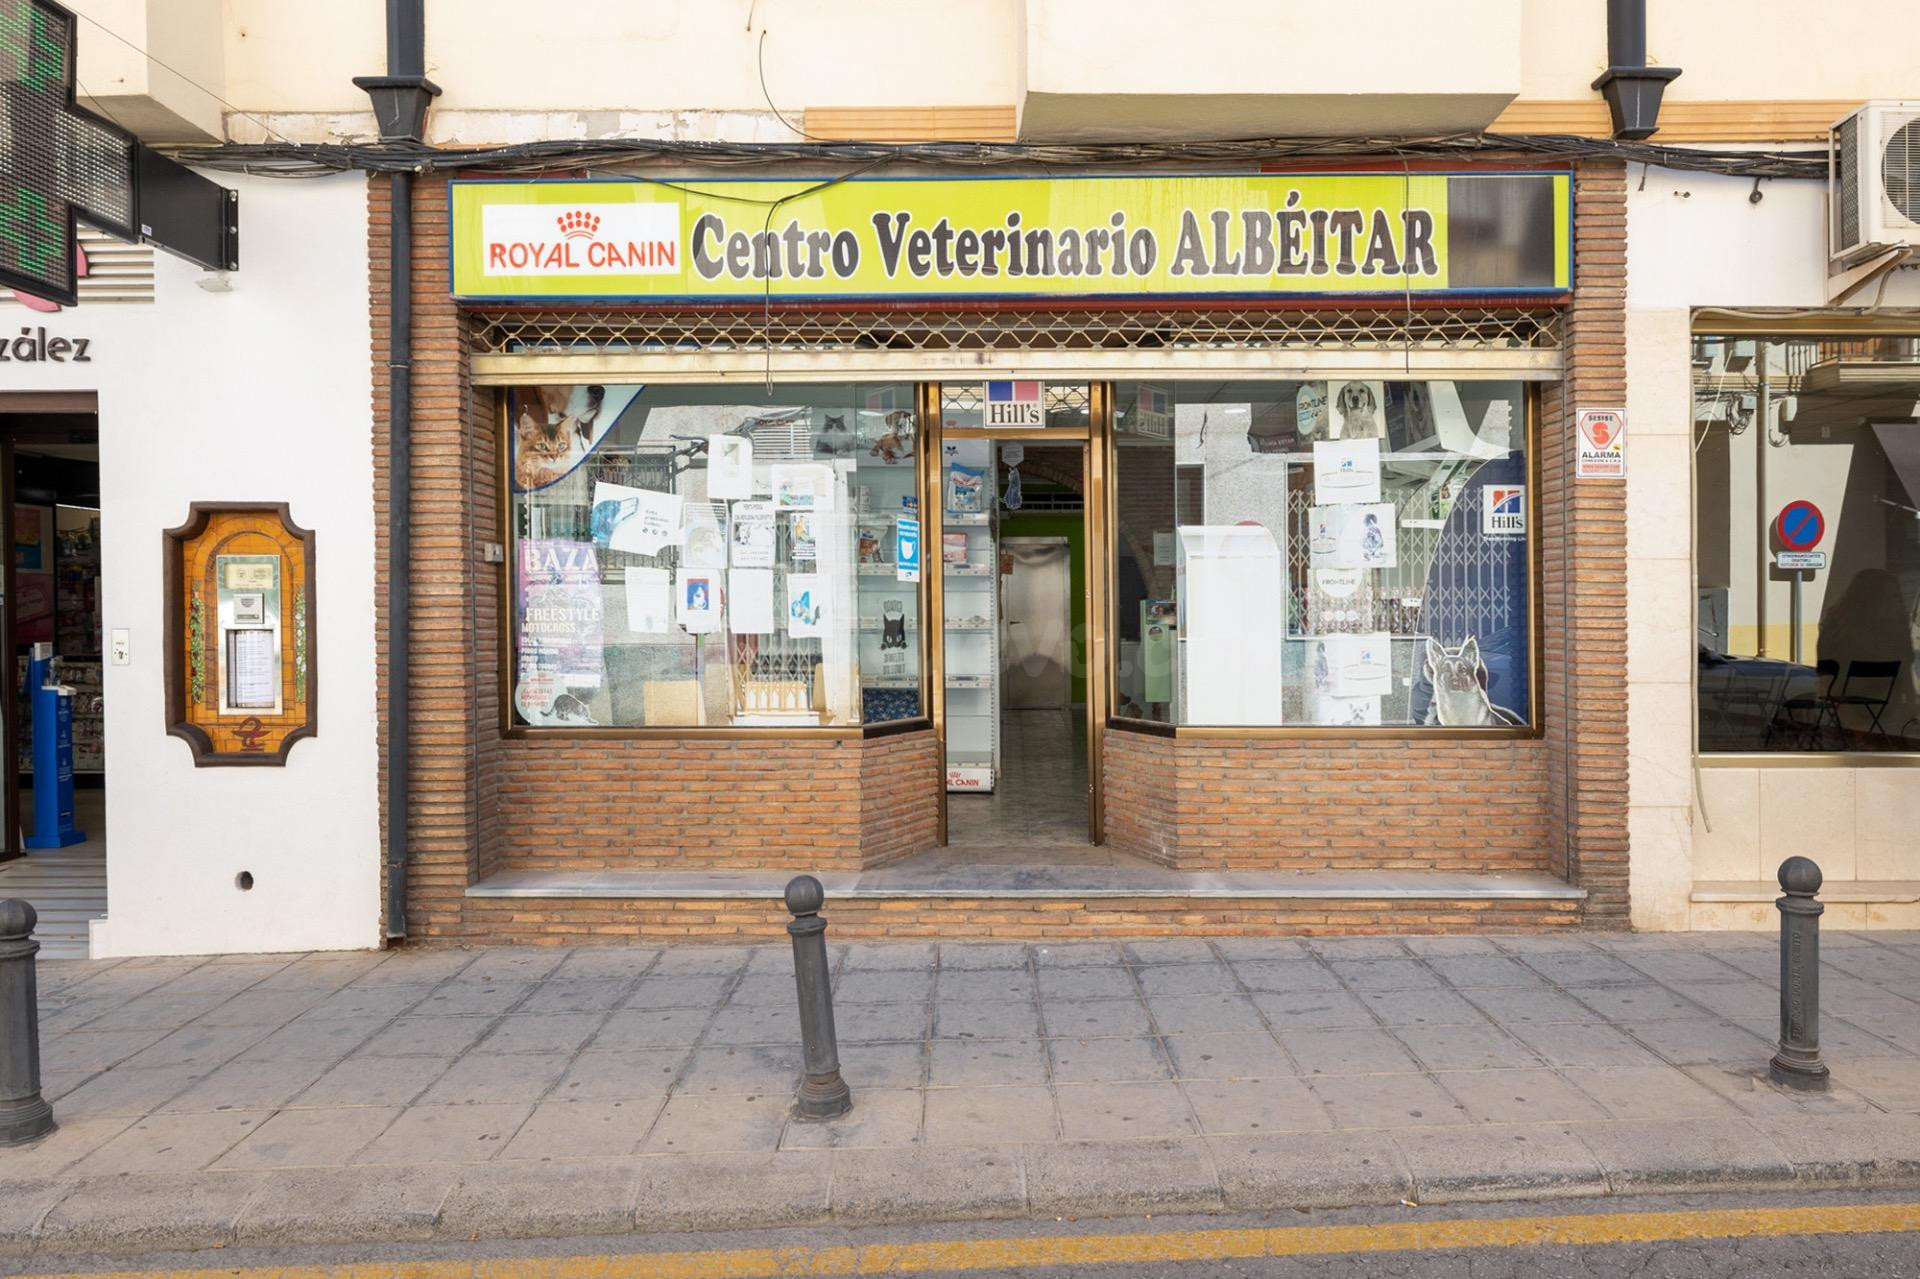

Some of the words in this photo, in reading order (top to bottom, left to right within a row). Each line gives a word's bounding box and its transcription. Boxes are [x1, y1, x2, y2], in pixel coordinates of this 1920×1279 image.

[692, 213, 860, 279] Centro
[871, 211, 1157, 278] Veterinario
[1170, 190, 1439, 275] ALBÉITAR
[489, 242, 580, 268] ROYAL
[588, 240, 676, 268] CANIN
[989, 402, 1040, 424] Hill's
[1582, 451, 1621, 459] ALARMA
[1491, 516, 1524, 528] Hill's
[524, 548, 599, 571] BAZA
[525, 607, 600, 622] FREESTYLE
[521, 622, 577, 633] MOTOCROSS
